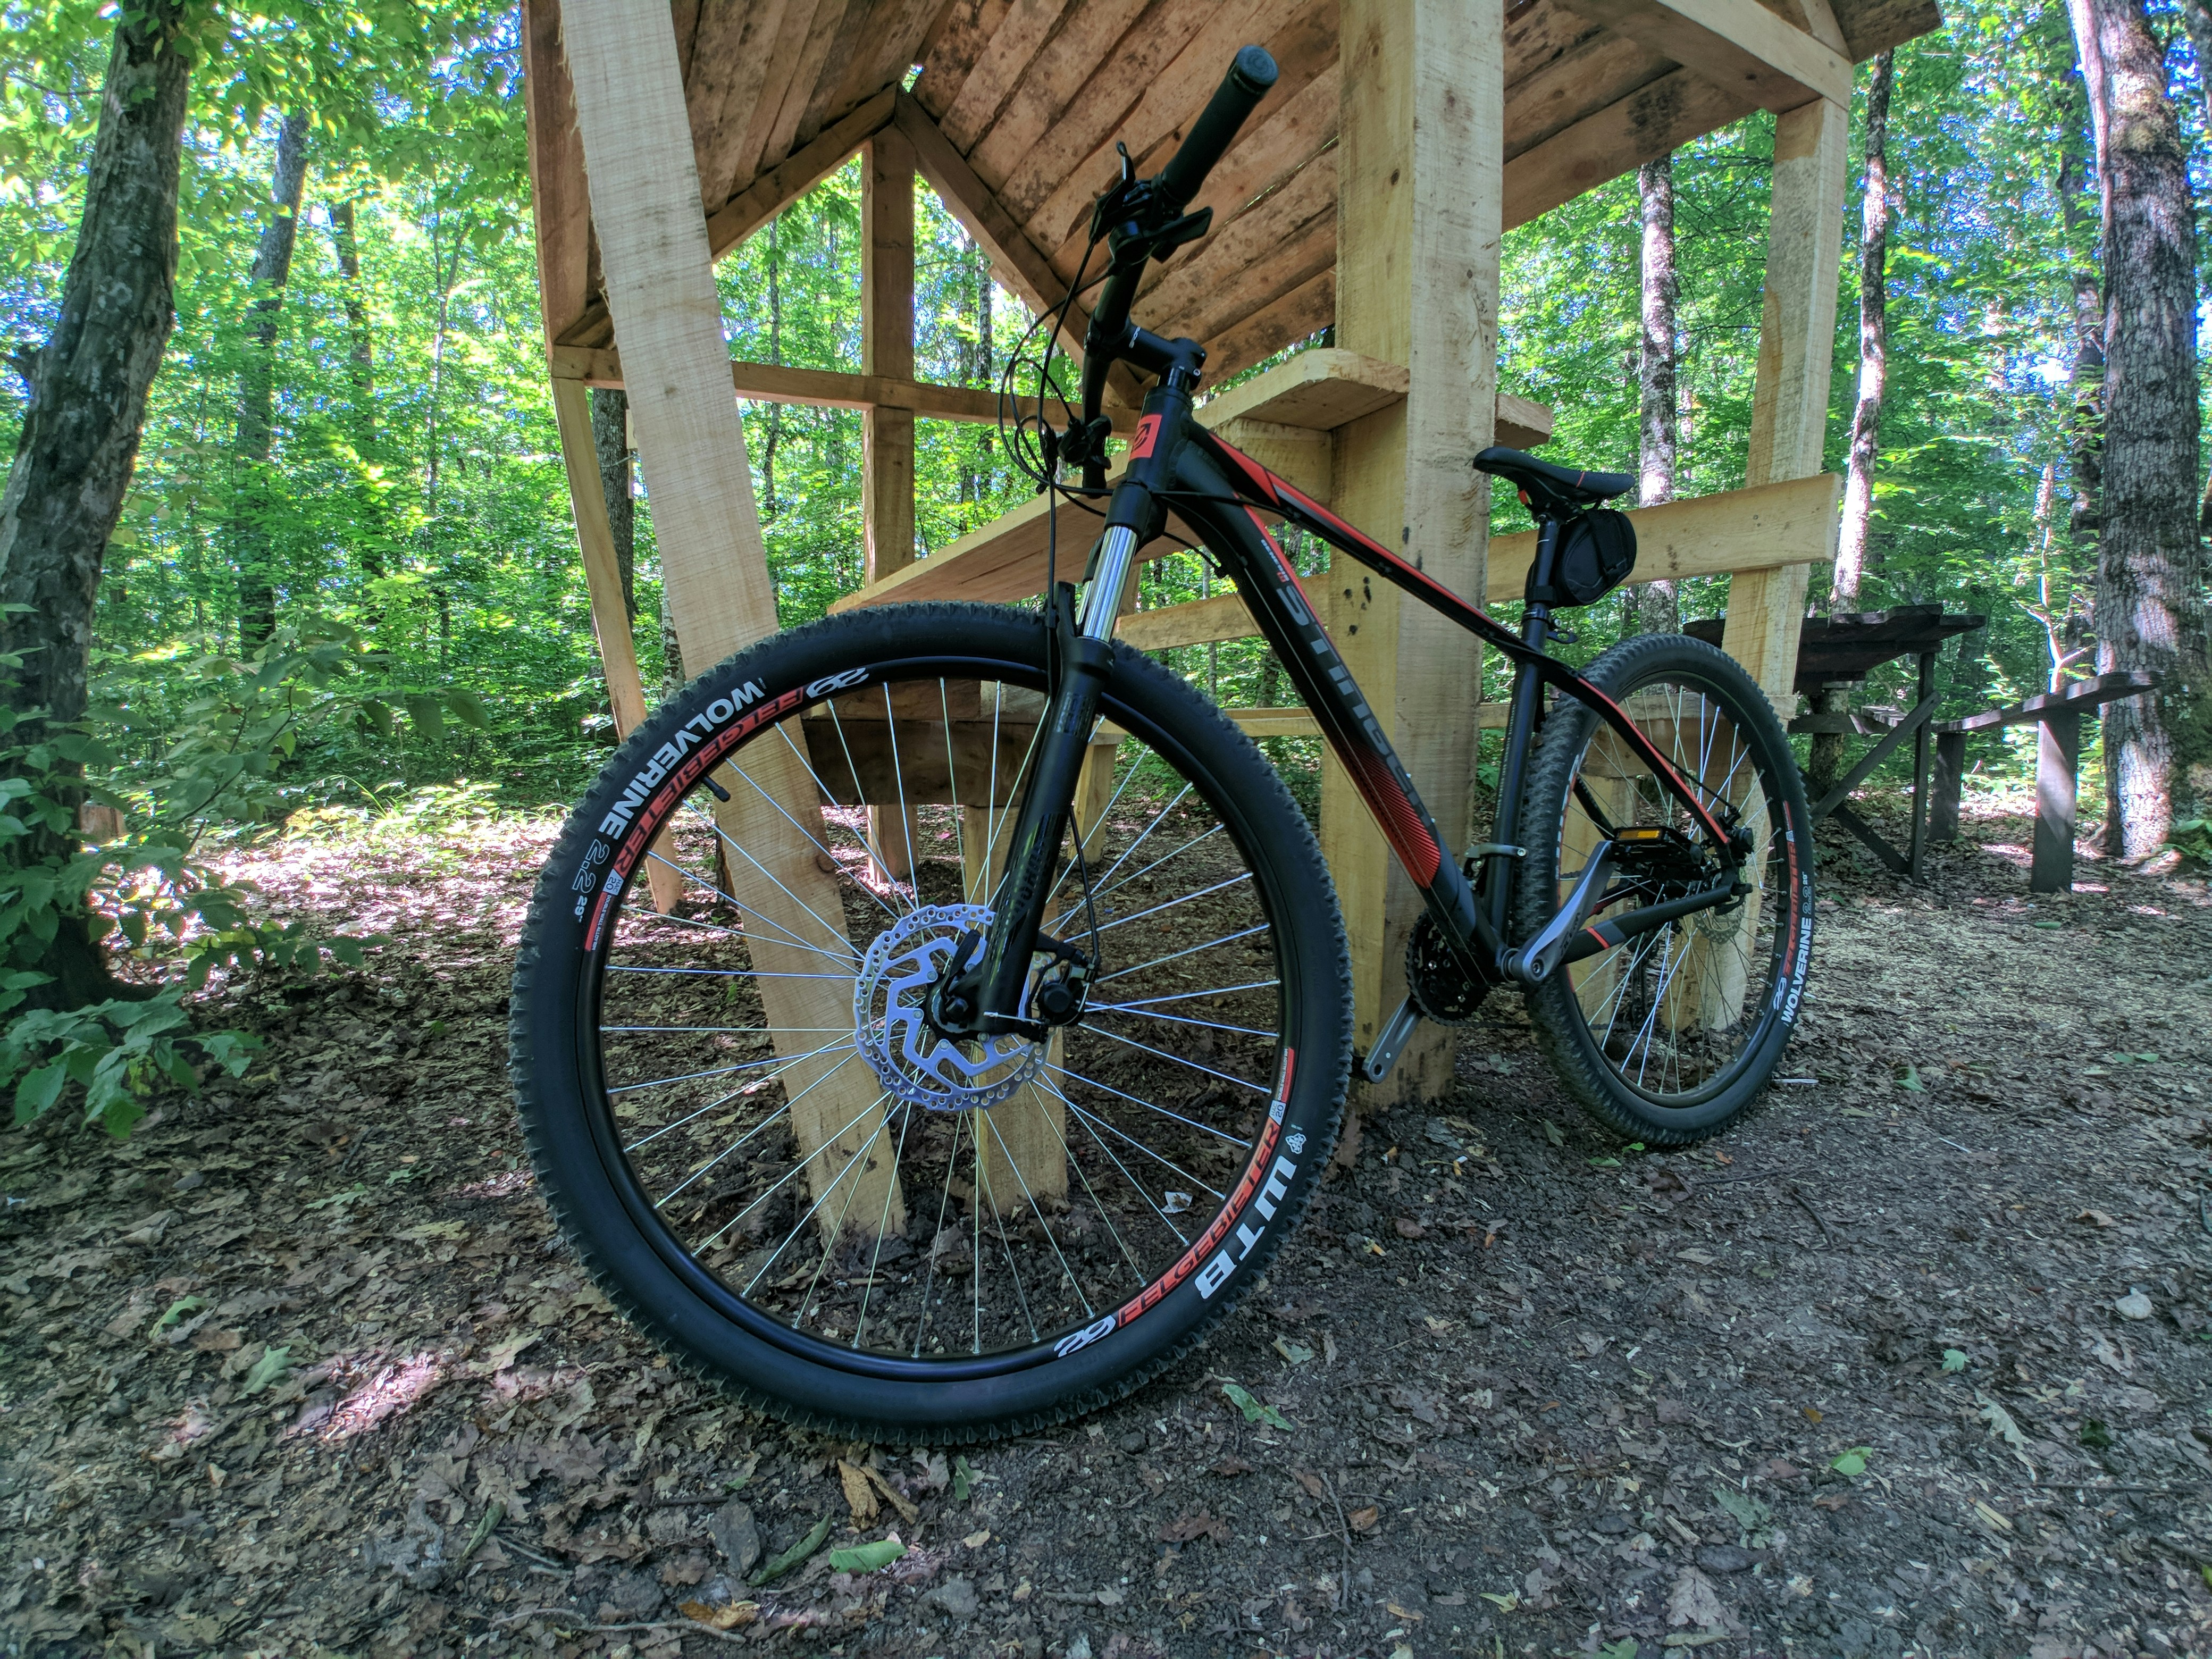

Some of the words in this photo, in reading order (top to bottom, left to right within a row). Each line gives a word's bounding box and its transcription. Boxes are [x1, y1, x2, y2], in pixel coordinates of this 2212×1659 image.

[806, 667, 869, 698] 29
[599, 680, 766, 840] WOLVERINE
[614, 690, 800, 872] FELGEBIETER
[572, 839, 610, 893] 2.2
[606, 876, 616, 890] 20
[613, 879, 622, 893] HAC
[1781, 917, 1812, 1023] WOLVERINE
[1276, 1104, 1284, 1118] 20
[1121, 1122, 1277, 1325] FELGEBIETER
[1194, 1155, 1297, 1299] WTB
[1053, 1315, 1116, 1358] 29
